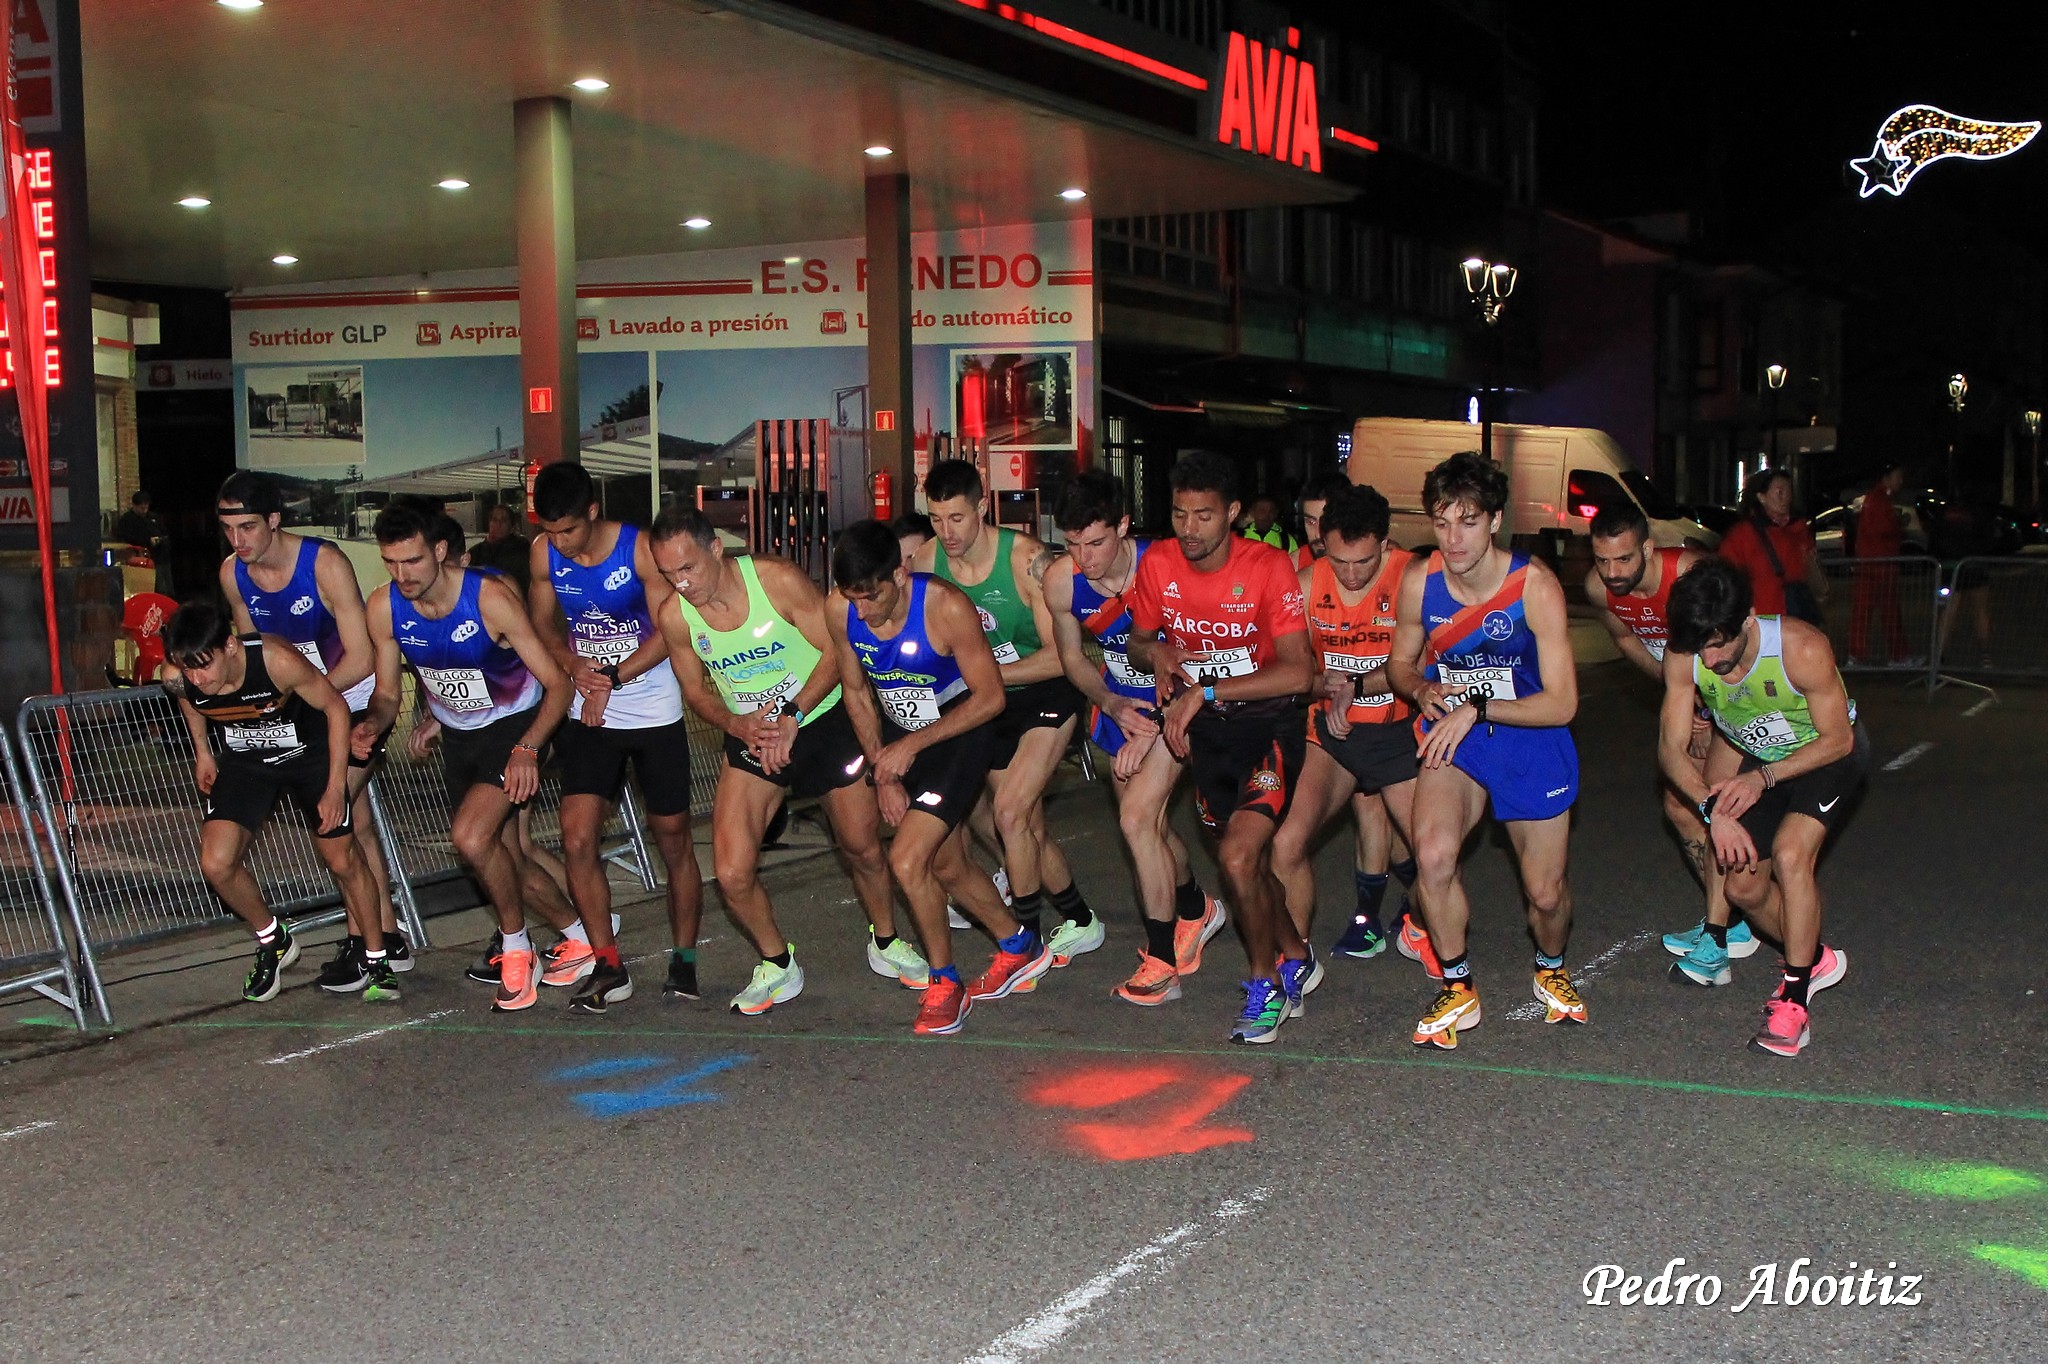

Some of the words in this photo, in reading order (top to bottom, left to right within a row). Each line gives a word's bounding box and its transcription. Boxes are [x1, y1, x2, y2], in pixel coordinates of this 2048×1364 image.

[761, 258, 840, 294] E.S.
[856, 252, 1043, 290] PNEDO
[609, 316, 686, 336] Lavado
[690, 320, 703, 334] a
[708, 312, 789, 338] presión
[857, 308, 937, 329] Ldo
[942, 305, 1073, 328] automático
[248, 329, 334, 347] Surtidor
[341, 325, 387, 344] GLP
[186, 369, 222, 381] Hielo
[566, 617, 640, 639] orps.Sain
[580, 640, 631, 653] PIELAGOS
[1321, 631, 1391, 647] REINOSA
[705, 641, 785, 671] MAINSA
[1465, 653, 1485, 667] DE
[423, 668, 475, 680] PIELAGOS
[1451, 670, 1504, 683] ELAGOS
[437, 681, 469, 699] 220
[738, 679, 791, 701] PIELAGOS
[881, 688, 927, 700] ELAGOS
[231, 728, 288, 739] PIELAGOS
[1752, 735, 1788, 753] AGOS
